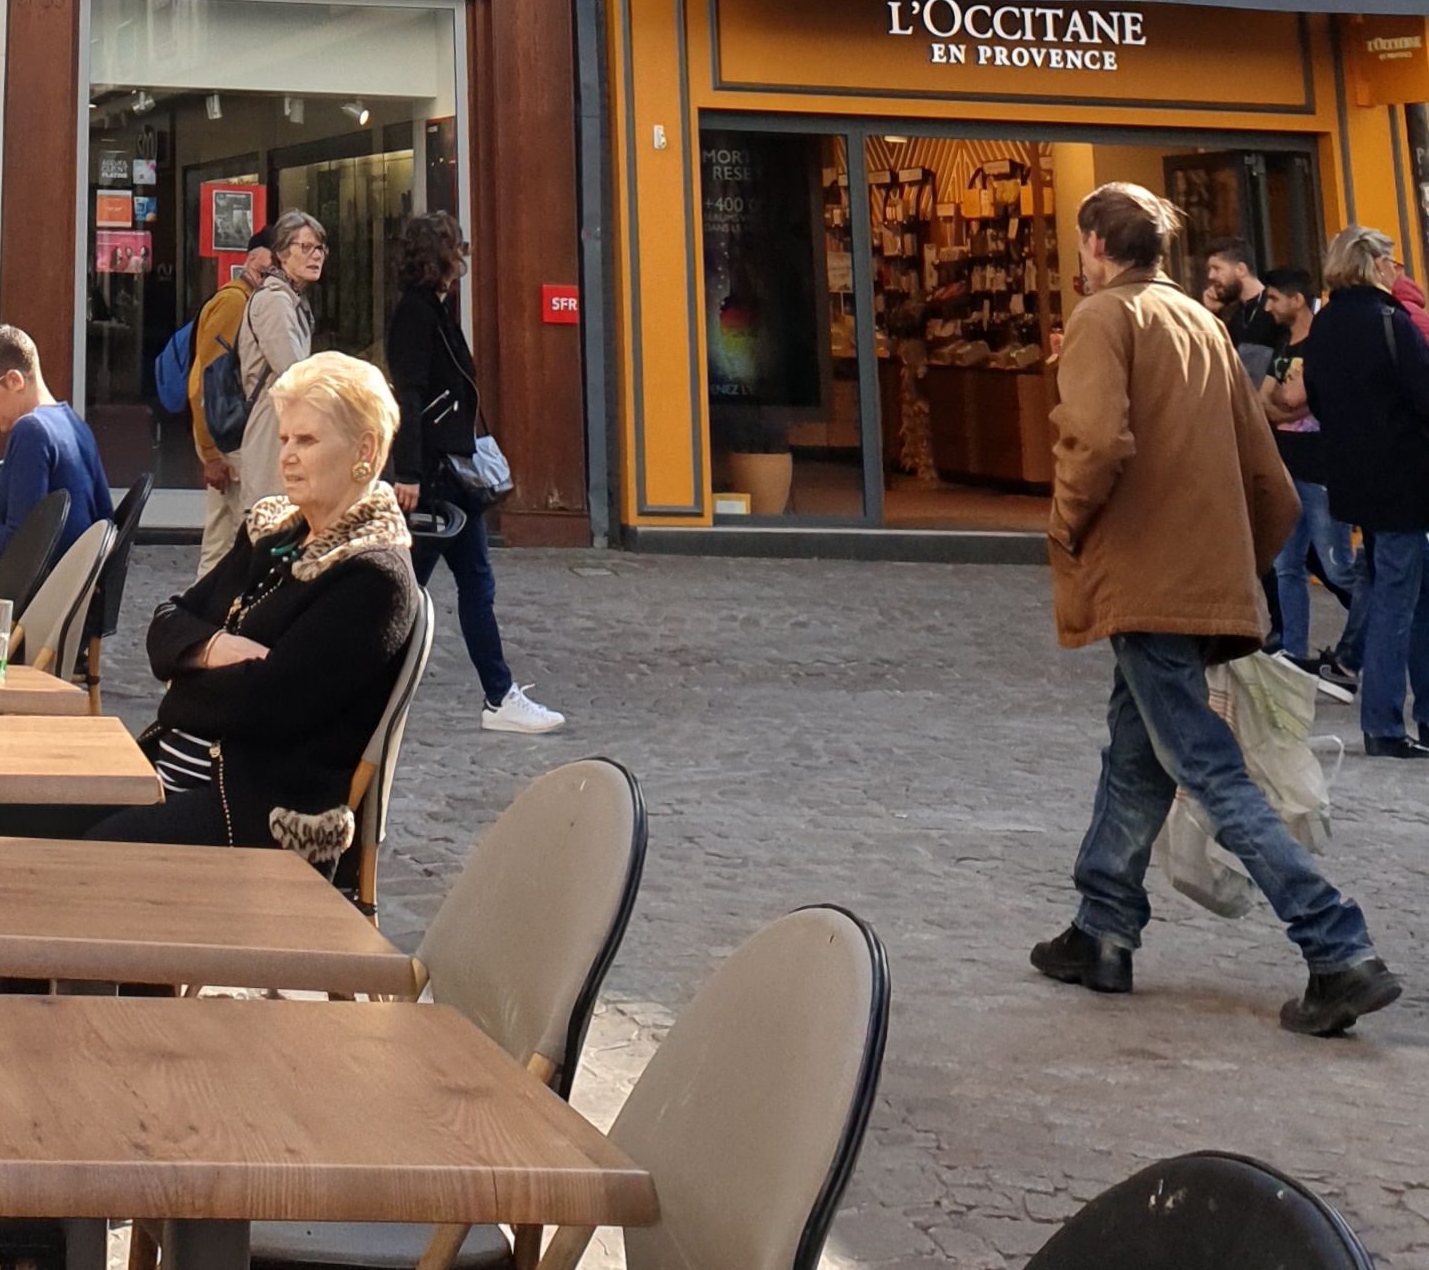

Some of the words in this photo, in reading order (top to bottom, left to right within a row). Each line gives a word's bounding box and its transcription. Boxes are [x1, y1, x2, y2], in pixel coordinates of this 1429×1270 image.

[931, 43, 967, 65] EN
[978, 44, 1119, 72] PROVENCE
[712, 165, 758, 181] RESE
[551, 296, 578, 311] SFR
